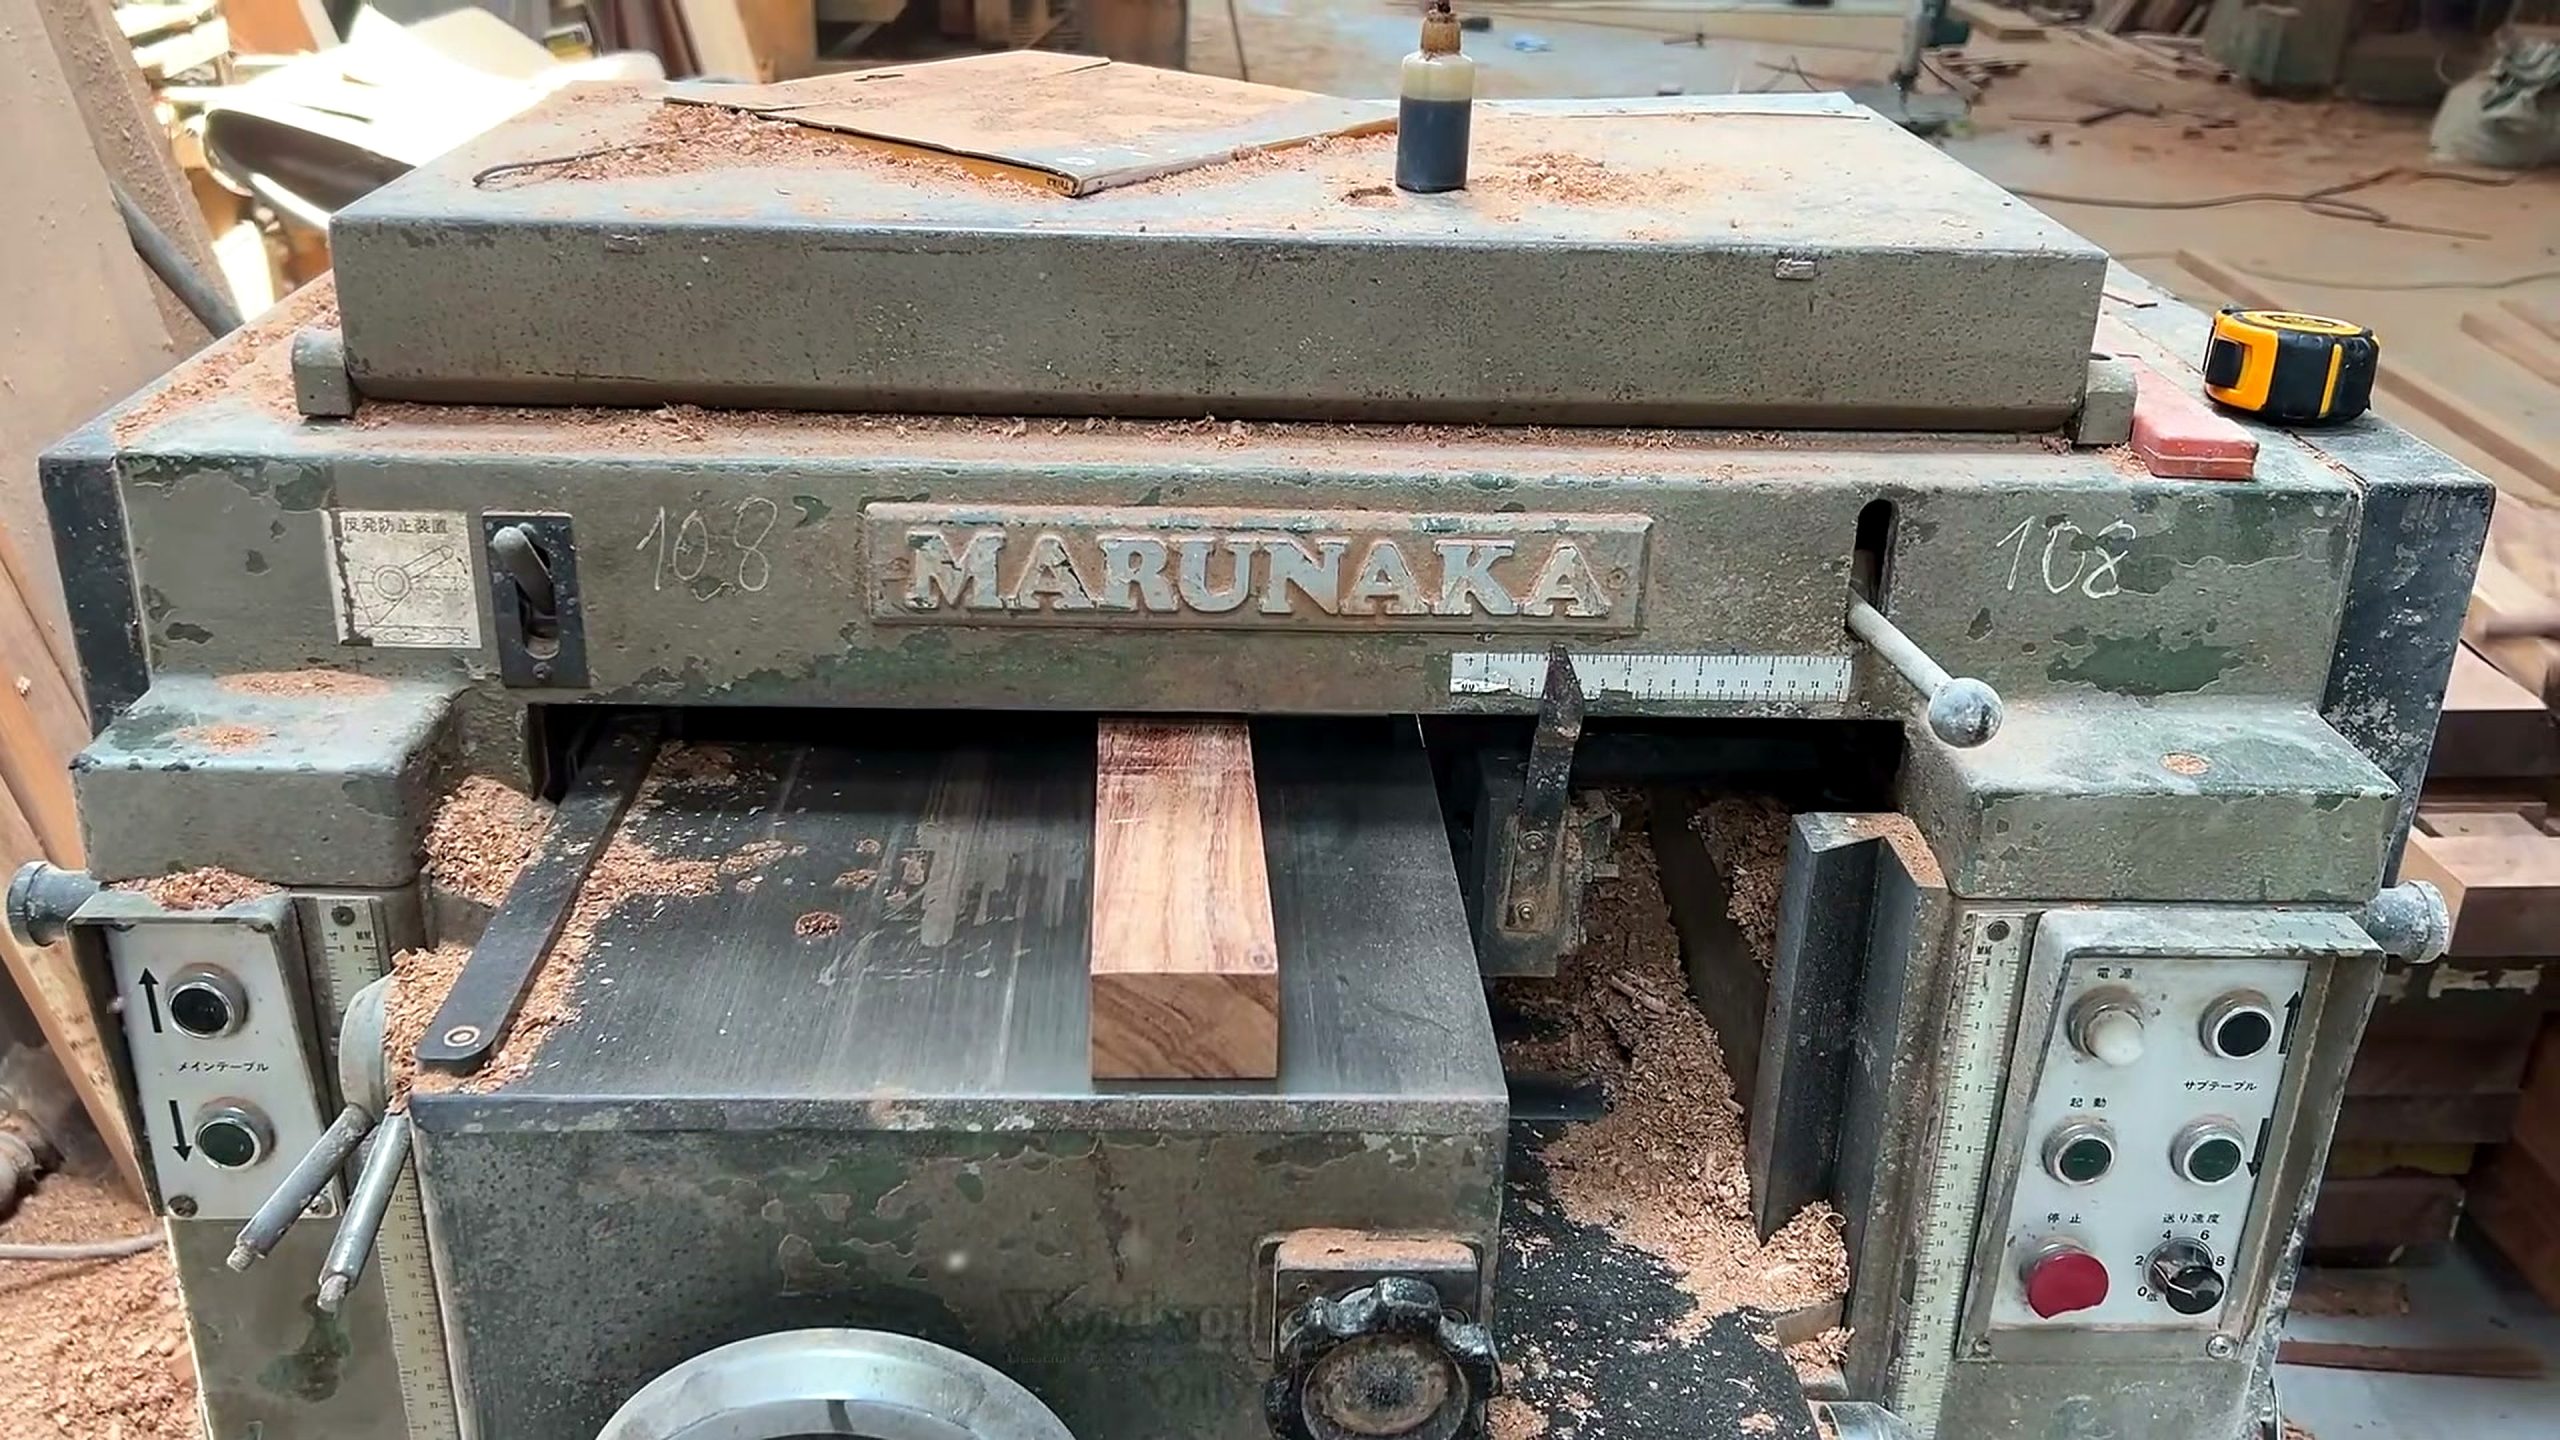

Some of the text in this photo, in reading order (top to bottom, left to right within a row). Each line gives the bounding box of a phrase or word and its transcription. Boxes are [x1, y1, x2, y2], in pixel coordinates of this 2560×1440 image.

[344, 517, 448, 535] 反発防止装置
[1996, 514, 2137, 599] 108
[905, 526, 1612, 618] MARUNAKA
[178, 1061, 269, 1073] メインテーブル
[2184, 1080, 2258, 1092] サブテーブル
[2162, 1213, 2220, 1224] 送り速度
[2162, 1229, 2210, 1241] 4 6
[2134, 1255, 2225, 1267] 2 8
[2137, 1286, 2148, 1297] 0
